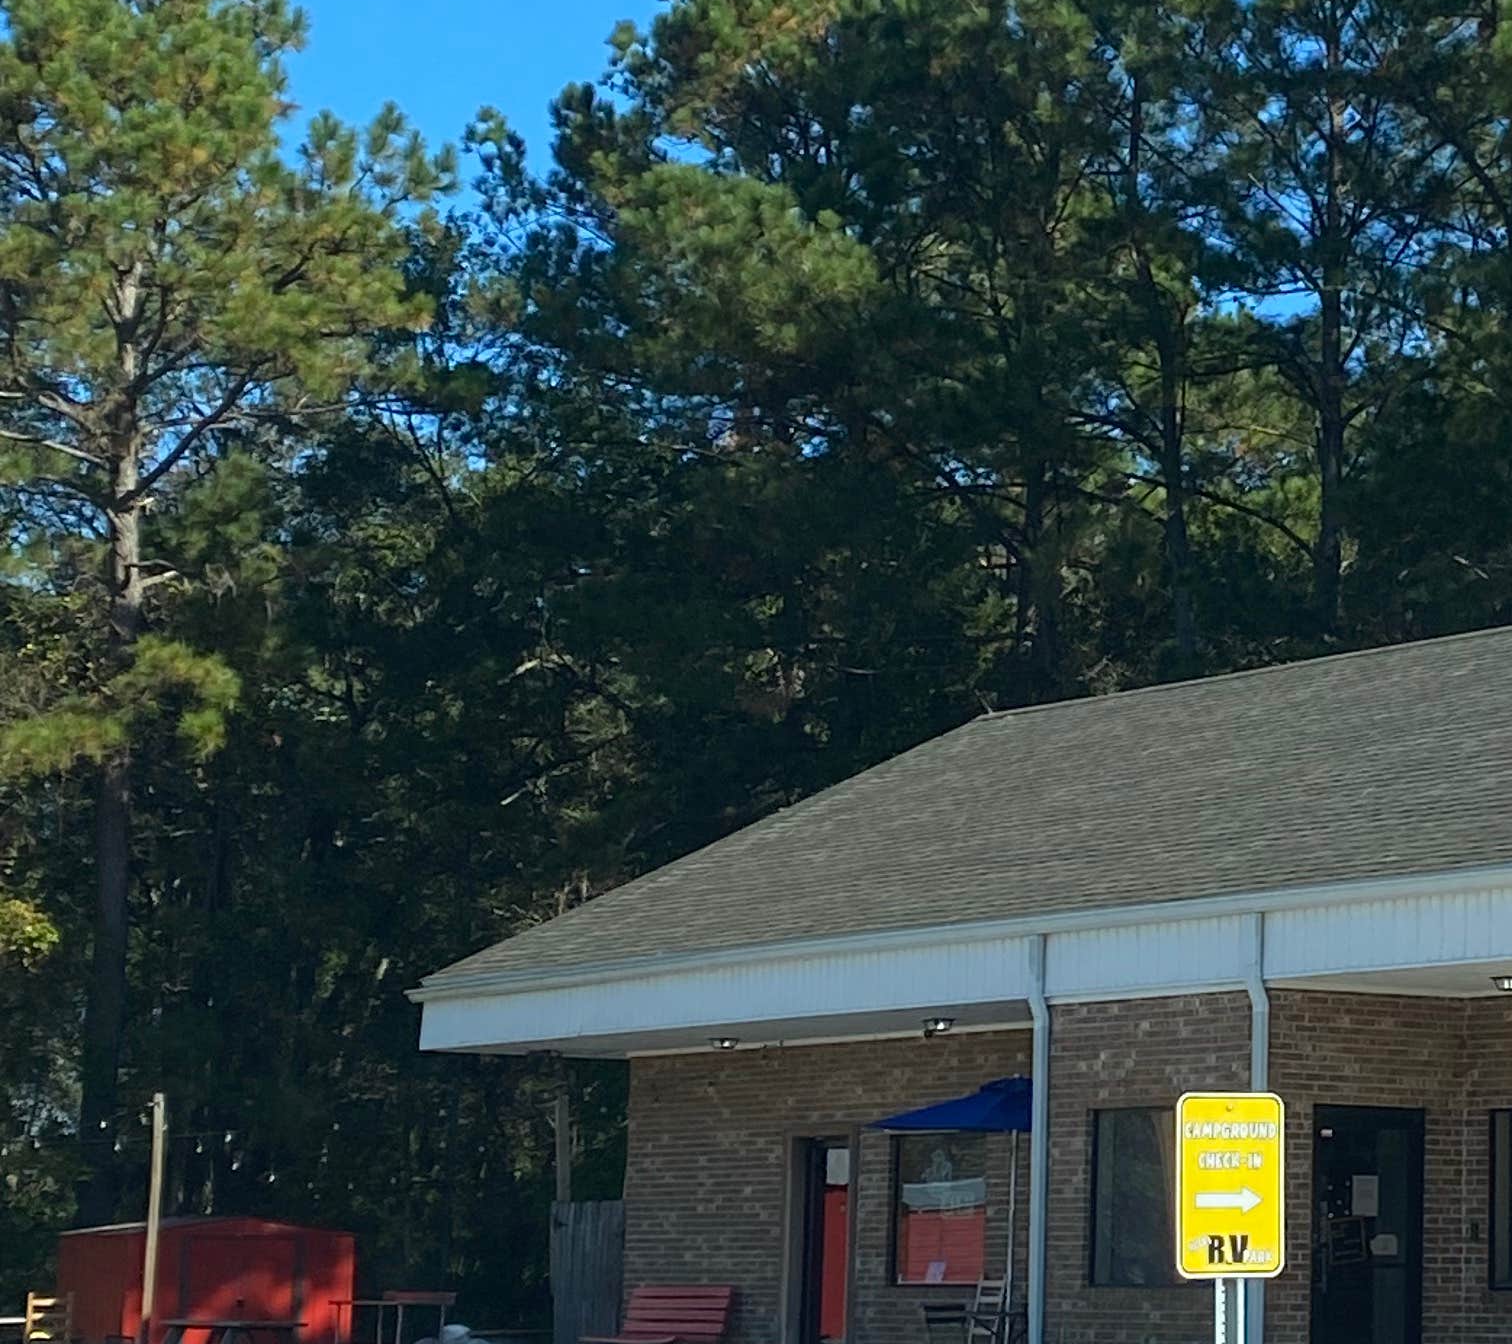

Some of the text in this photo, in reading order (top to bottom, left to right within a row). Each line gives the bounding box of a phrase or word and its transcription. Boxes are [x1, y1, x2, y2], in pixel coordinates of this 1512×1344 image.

[1184, 1122, 1277, 1140] CAMPGROUND
[1198, 1151, 1263, 1169] CHECK-IN
[1208, 1234, 1248, 1265] RV
